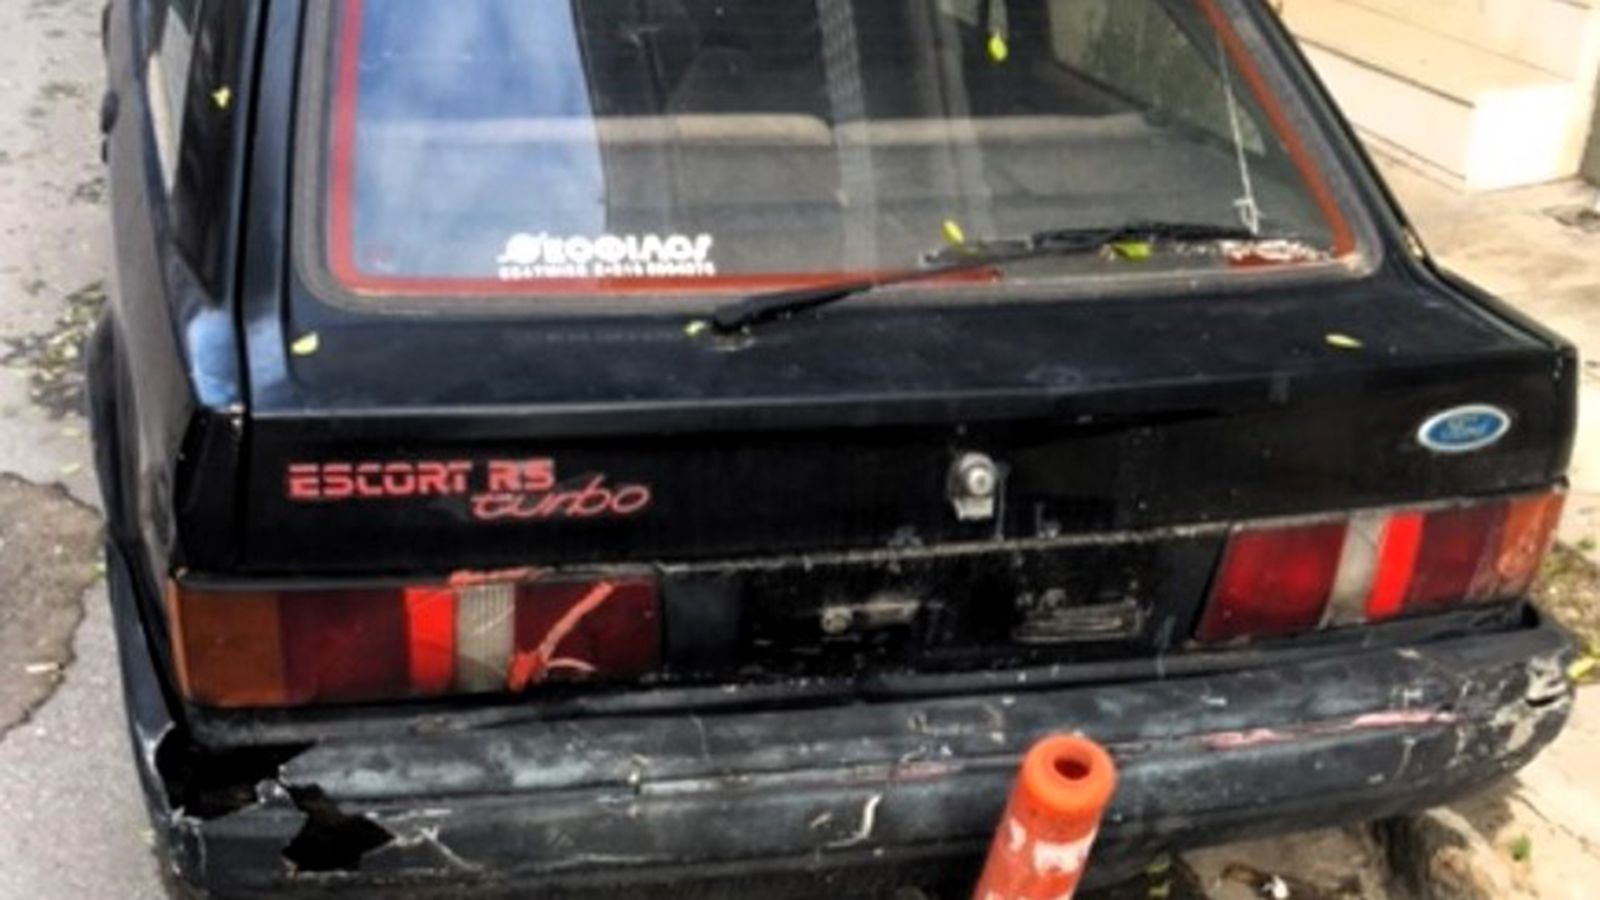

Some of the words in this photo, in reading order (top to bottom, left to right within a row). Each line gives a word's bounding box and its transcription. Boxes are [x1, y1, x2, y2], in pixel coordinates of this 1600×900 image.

[288, 462, 472, 498] ESCORT
[488, 459, 554, 492] RS
[471, 474, 650, 520] turbo
